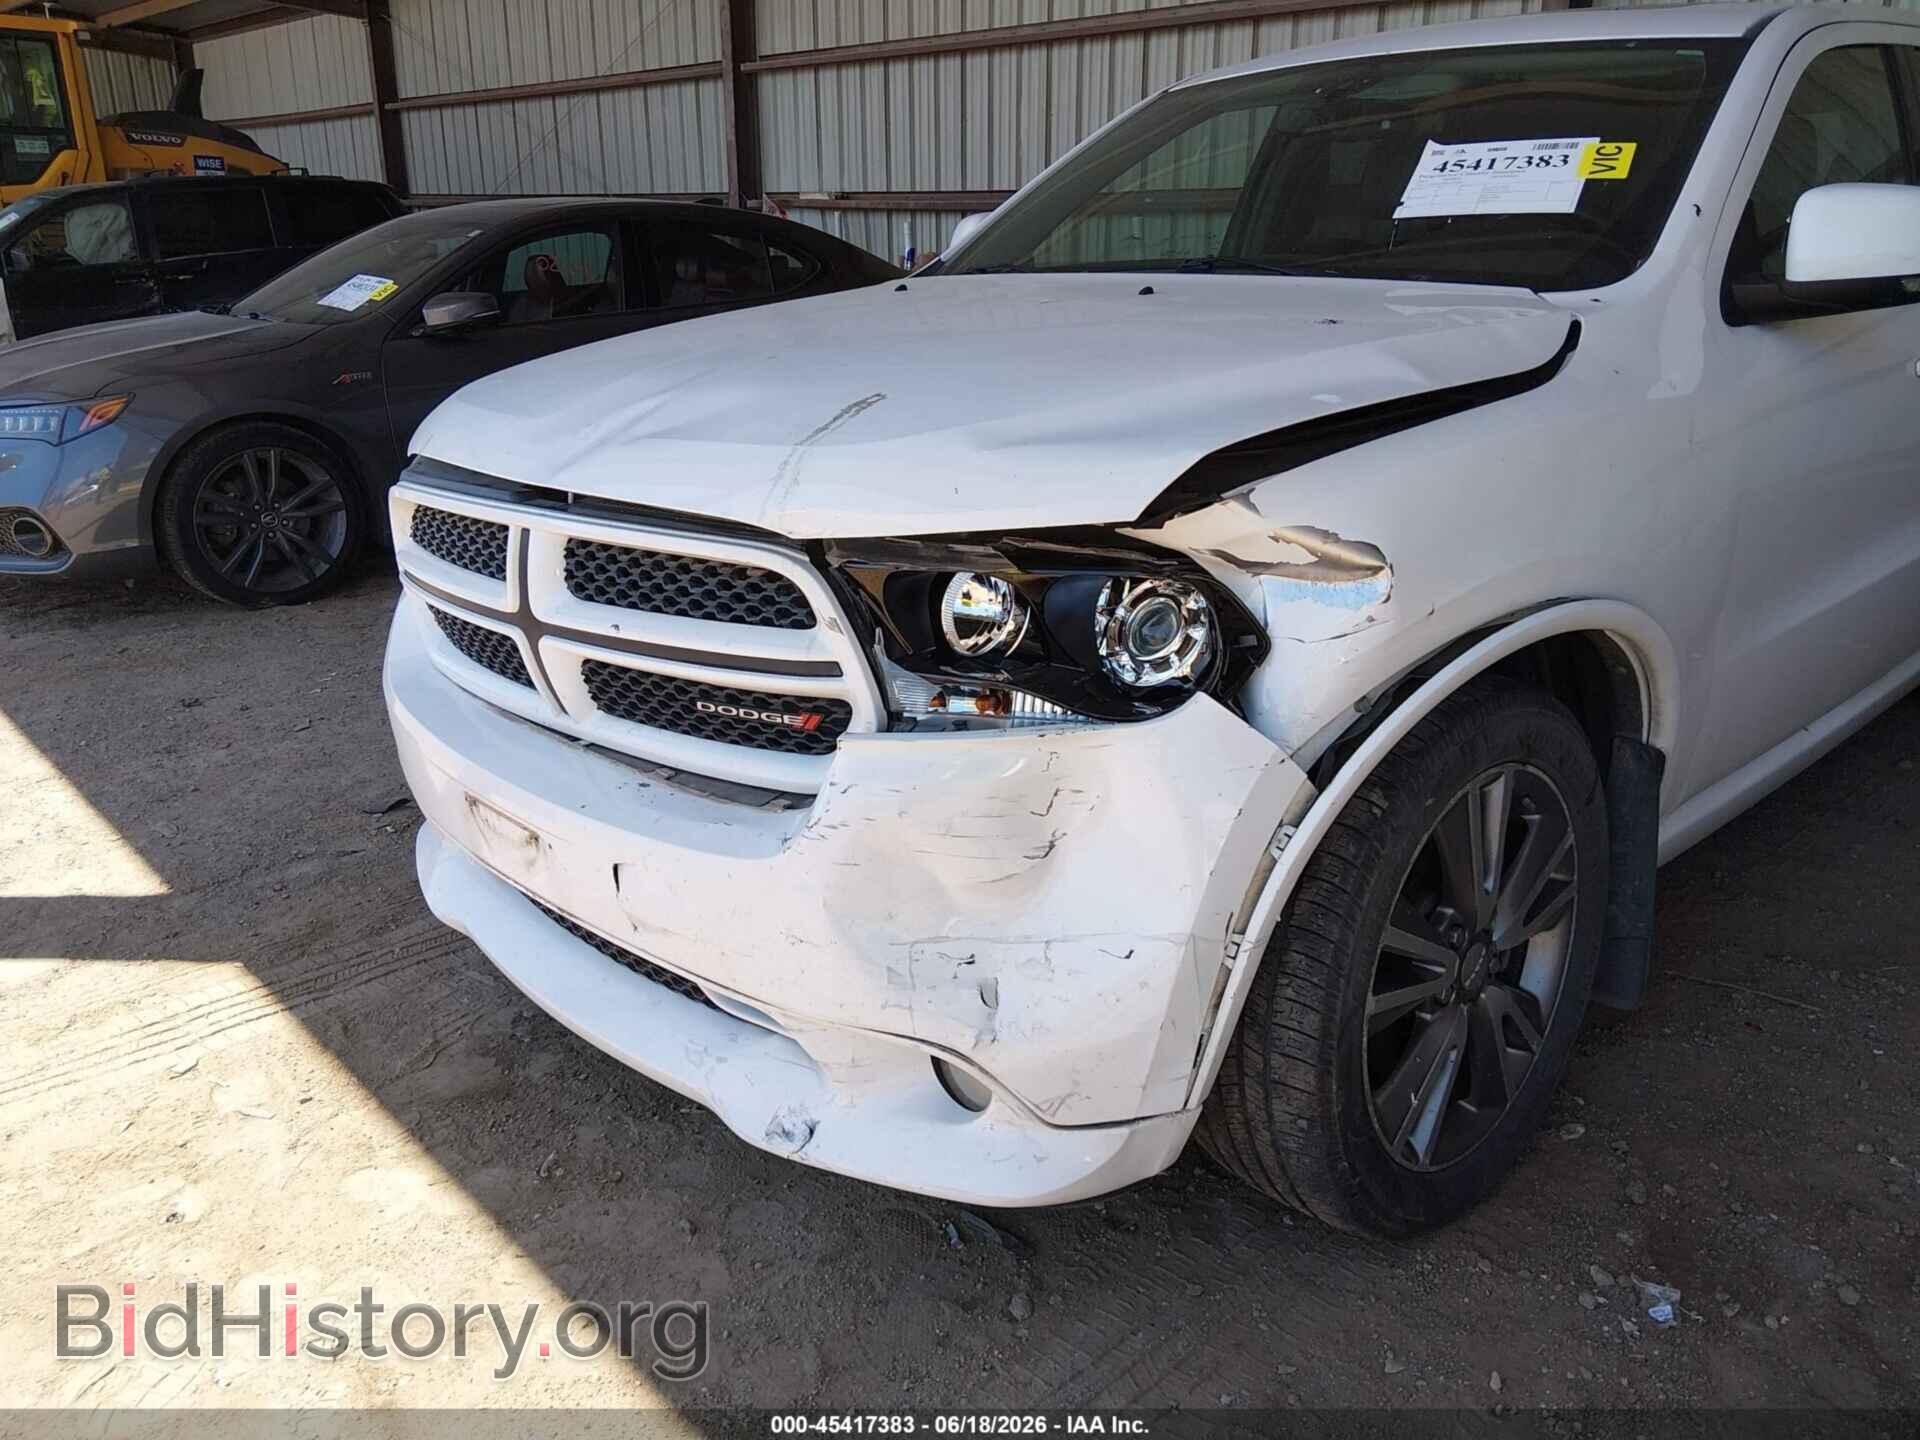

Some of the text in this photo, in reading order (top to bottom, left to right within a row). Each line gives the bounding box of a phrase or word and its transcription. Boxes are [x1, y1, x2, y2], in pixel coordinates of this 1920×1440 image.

[128, 133, 182, 144] VOLVO
[1432, 154, 1571, 173] 45417383
[1588, 145, 1623, 175] VIC
[696, 701, 805, 727] DODGE
